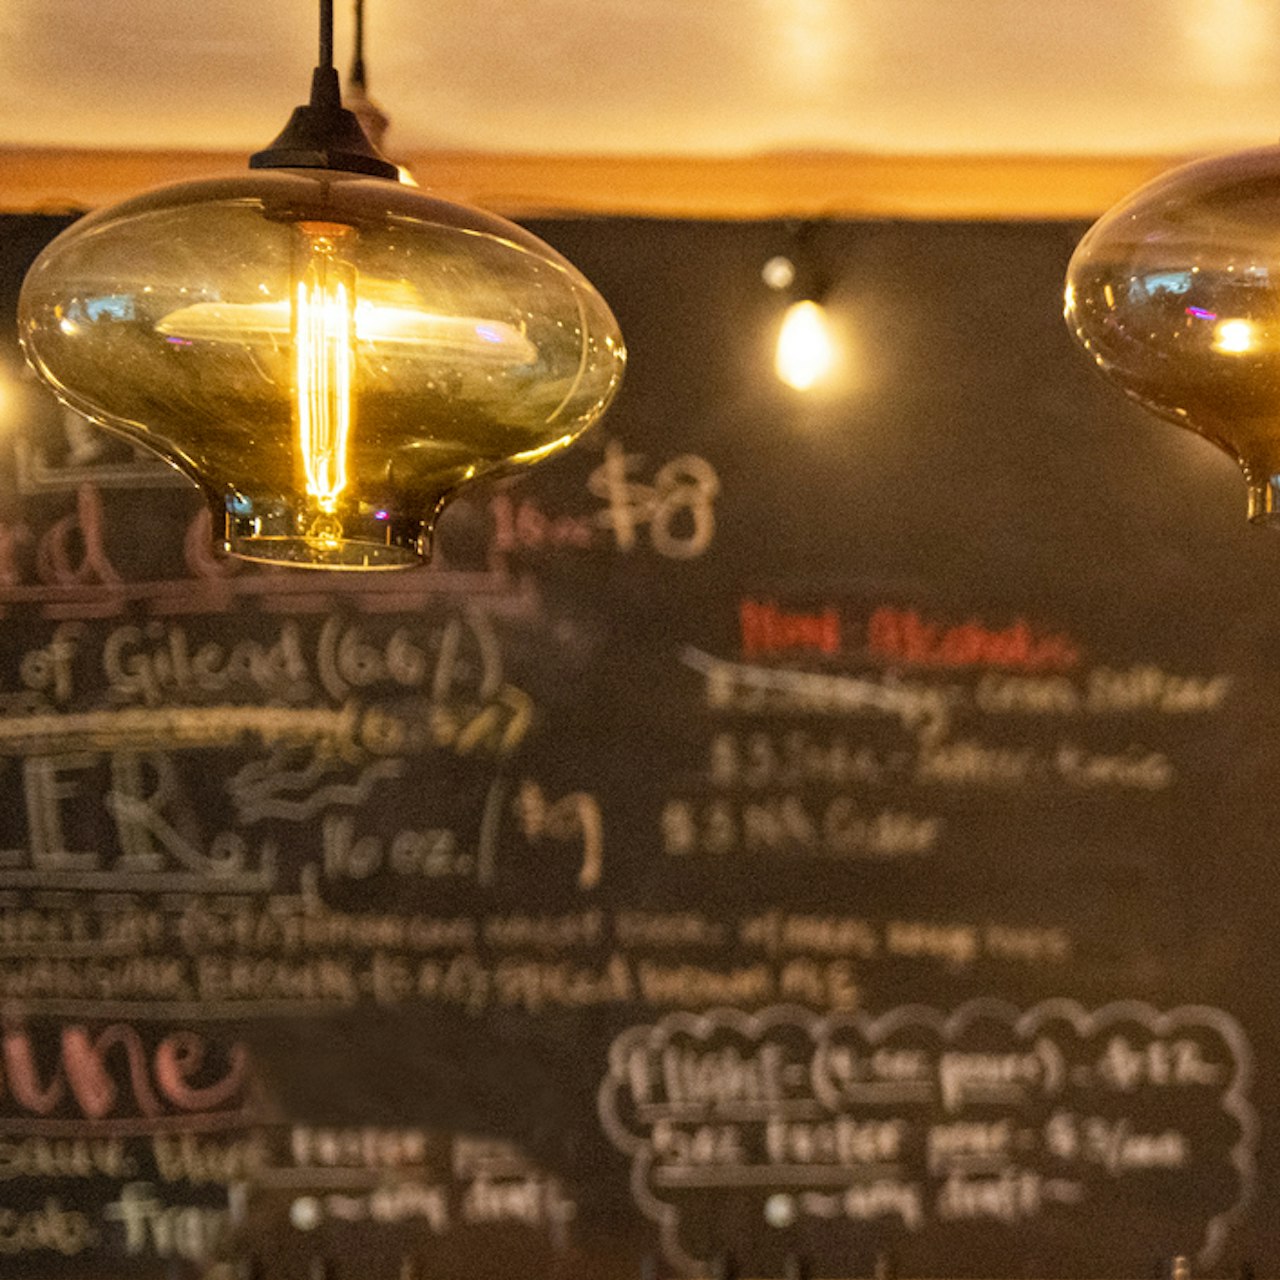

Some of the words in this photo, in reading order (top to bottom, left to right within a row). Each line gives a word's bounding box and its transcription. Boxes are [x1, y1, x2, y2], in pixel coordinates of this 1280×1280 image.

[589, 438, 721, 562] $8
[19, 622, 88, 698] of
[102, 622, 303, 698] Gilead
